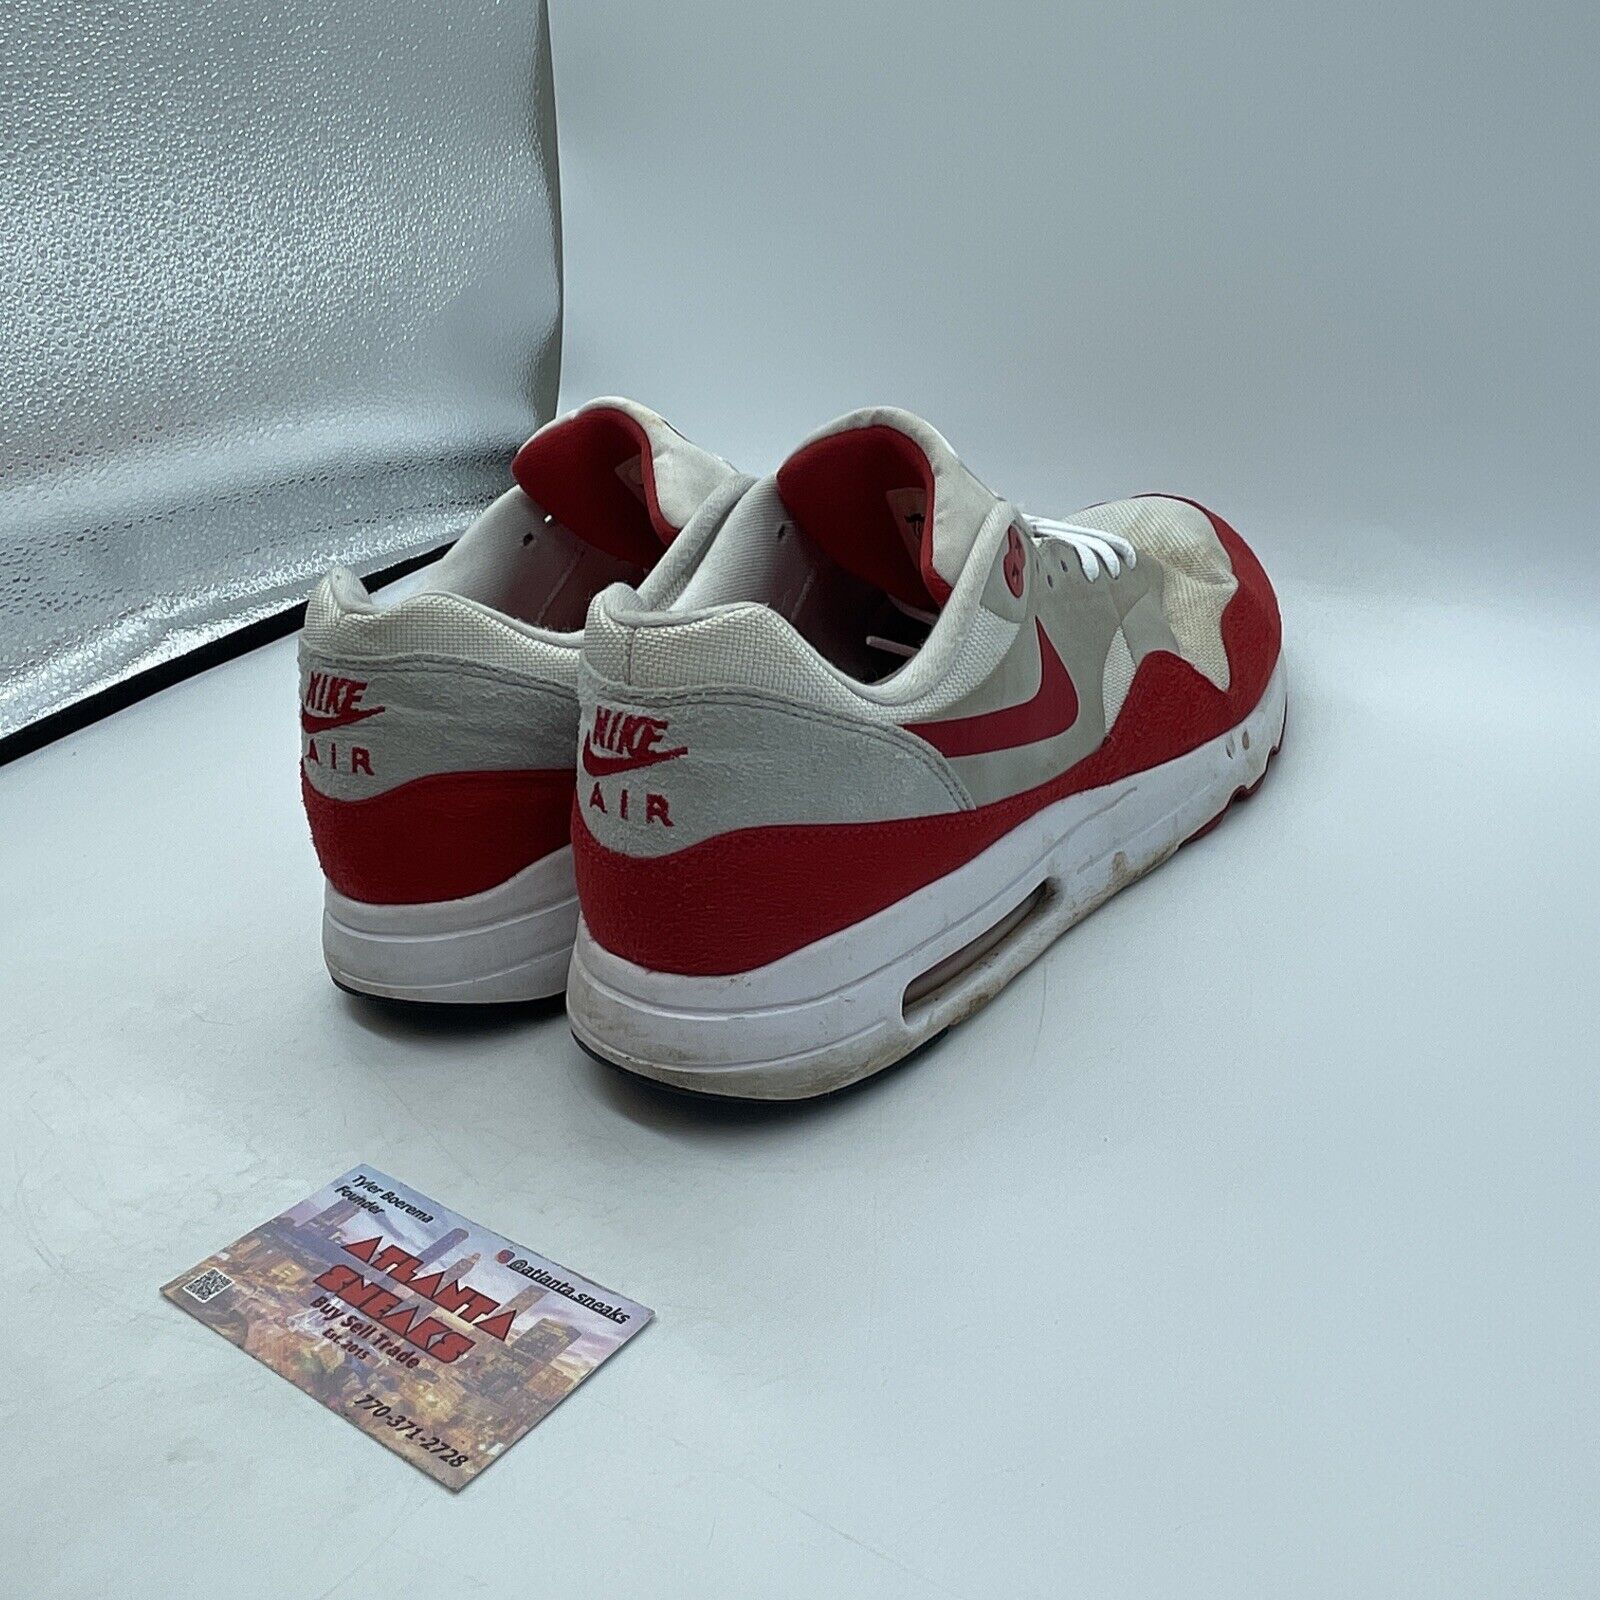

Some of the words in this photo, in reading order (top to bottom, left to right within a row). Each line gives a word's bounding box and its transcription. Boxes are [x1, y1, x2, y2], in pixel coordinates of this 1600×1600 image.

[305, 671, 368, 714] NIKE
[593, 705, 668, 755] NIKE
[305, 738, 375, 776] AIR
[590, 781, 675, 828] AIR
[334, 1185, 385, 1214] Founder
[352, 1175, 383, 1194] Tyler
[380, 1191, 434, 1223] Boerema
[313, 1264, 477, 1363] SNEAKS
[340, 1236, 517, 1342] ATLANTA
[506, 1259, 631, 1325] @atlanta.sneaks
[310, 1296, 345, 1321] Buy
[340, 1315, 378, 1340] Sell
[373, 1333, 420, 1369] Trade
[341, 1341, 370, 1360] 2015
[354, 1394, 469, 1468] 770-371-2728
